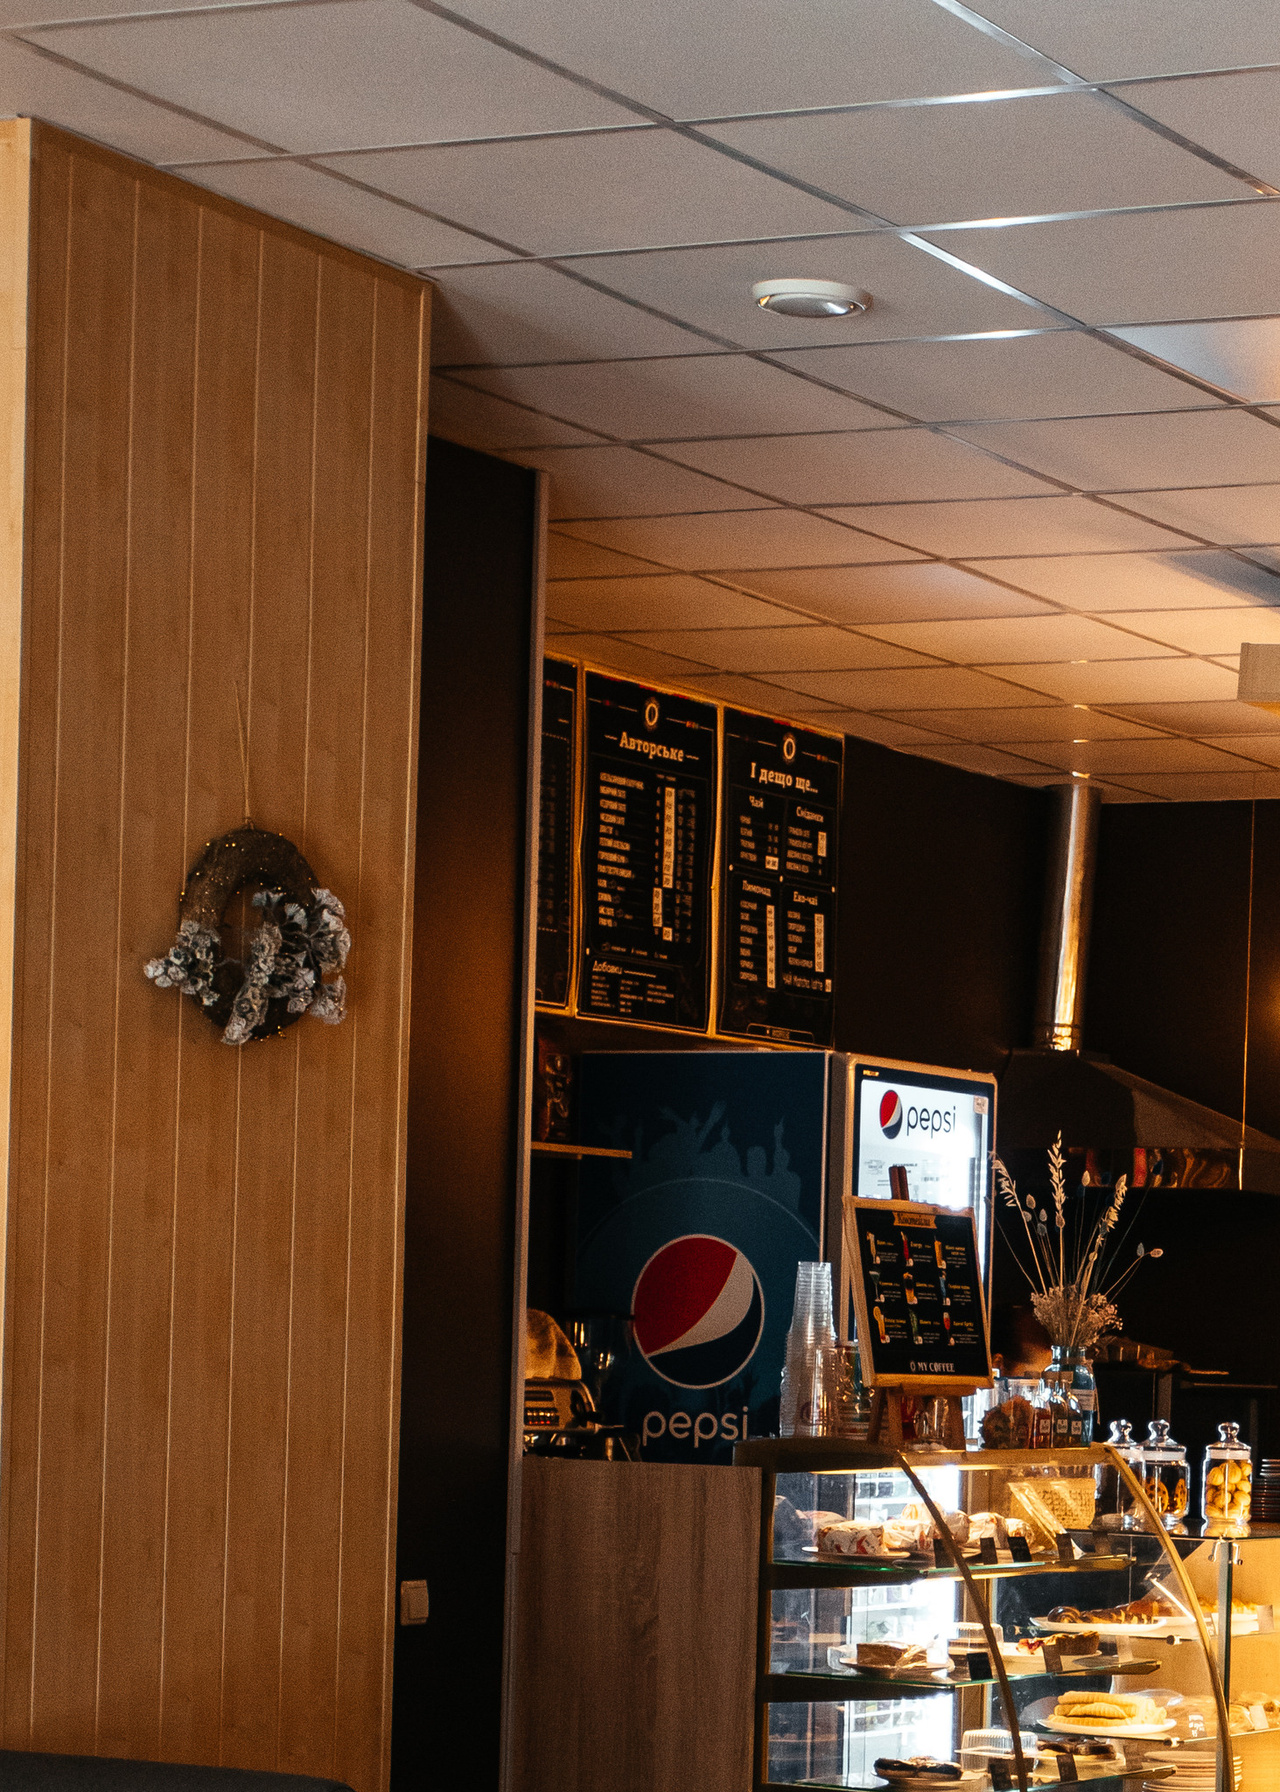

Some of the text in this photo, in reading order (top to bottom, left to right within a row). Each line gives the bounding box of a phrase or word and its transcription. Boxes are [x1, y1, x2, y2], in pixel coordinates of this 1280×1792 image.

[619, 731, 685, 762] Авторське
[759, 768, 793, 788] дещо
[907, 1105, 956, 1139] pepsi
[917, 1361, 928, 1372] MY
[929, 1362, 955, 1373] COFFEE
[642, 1406, 749, 1448] pepsi
